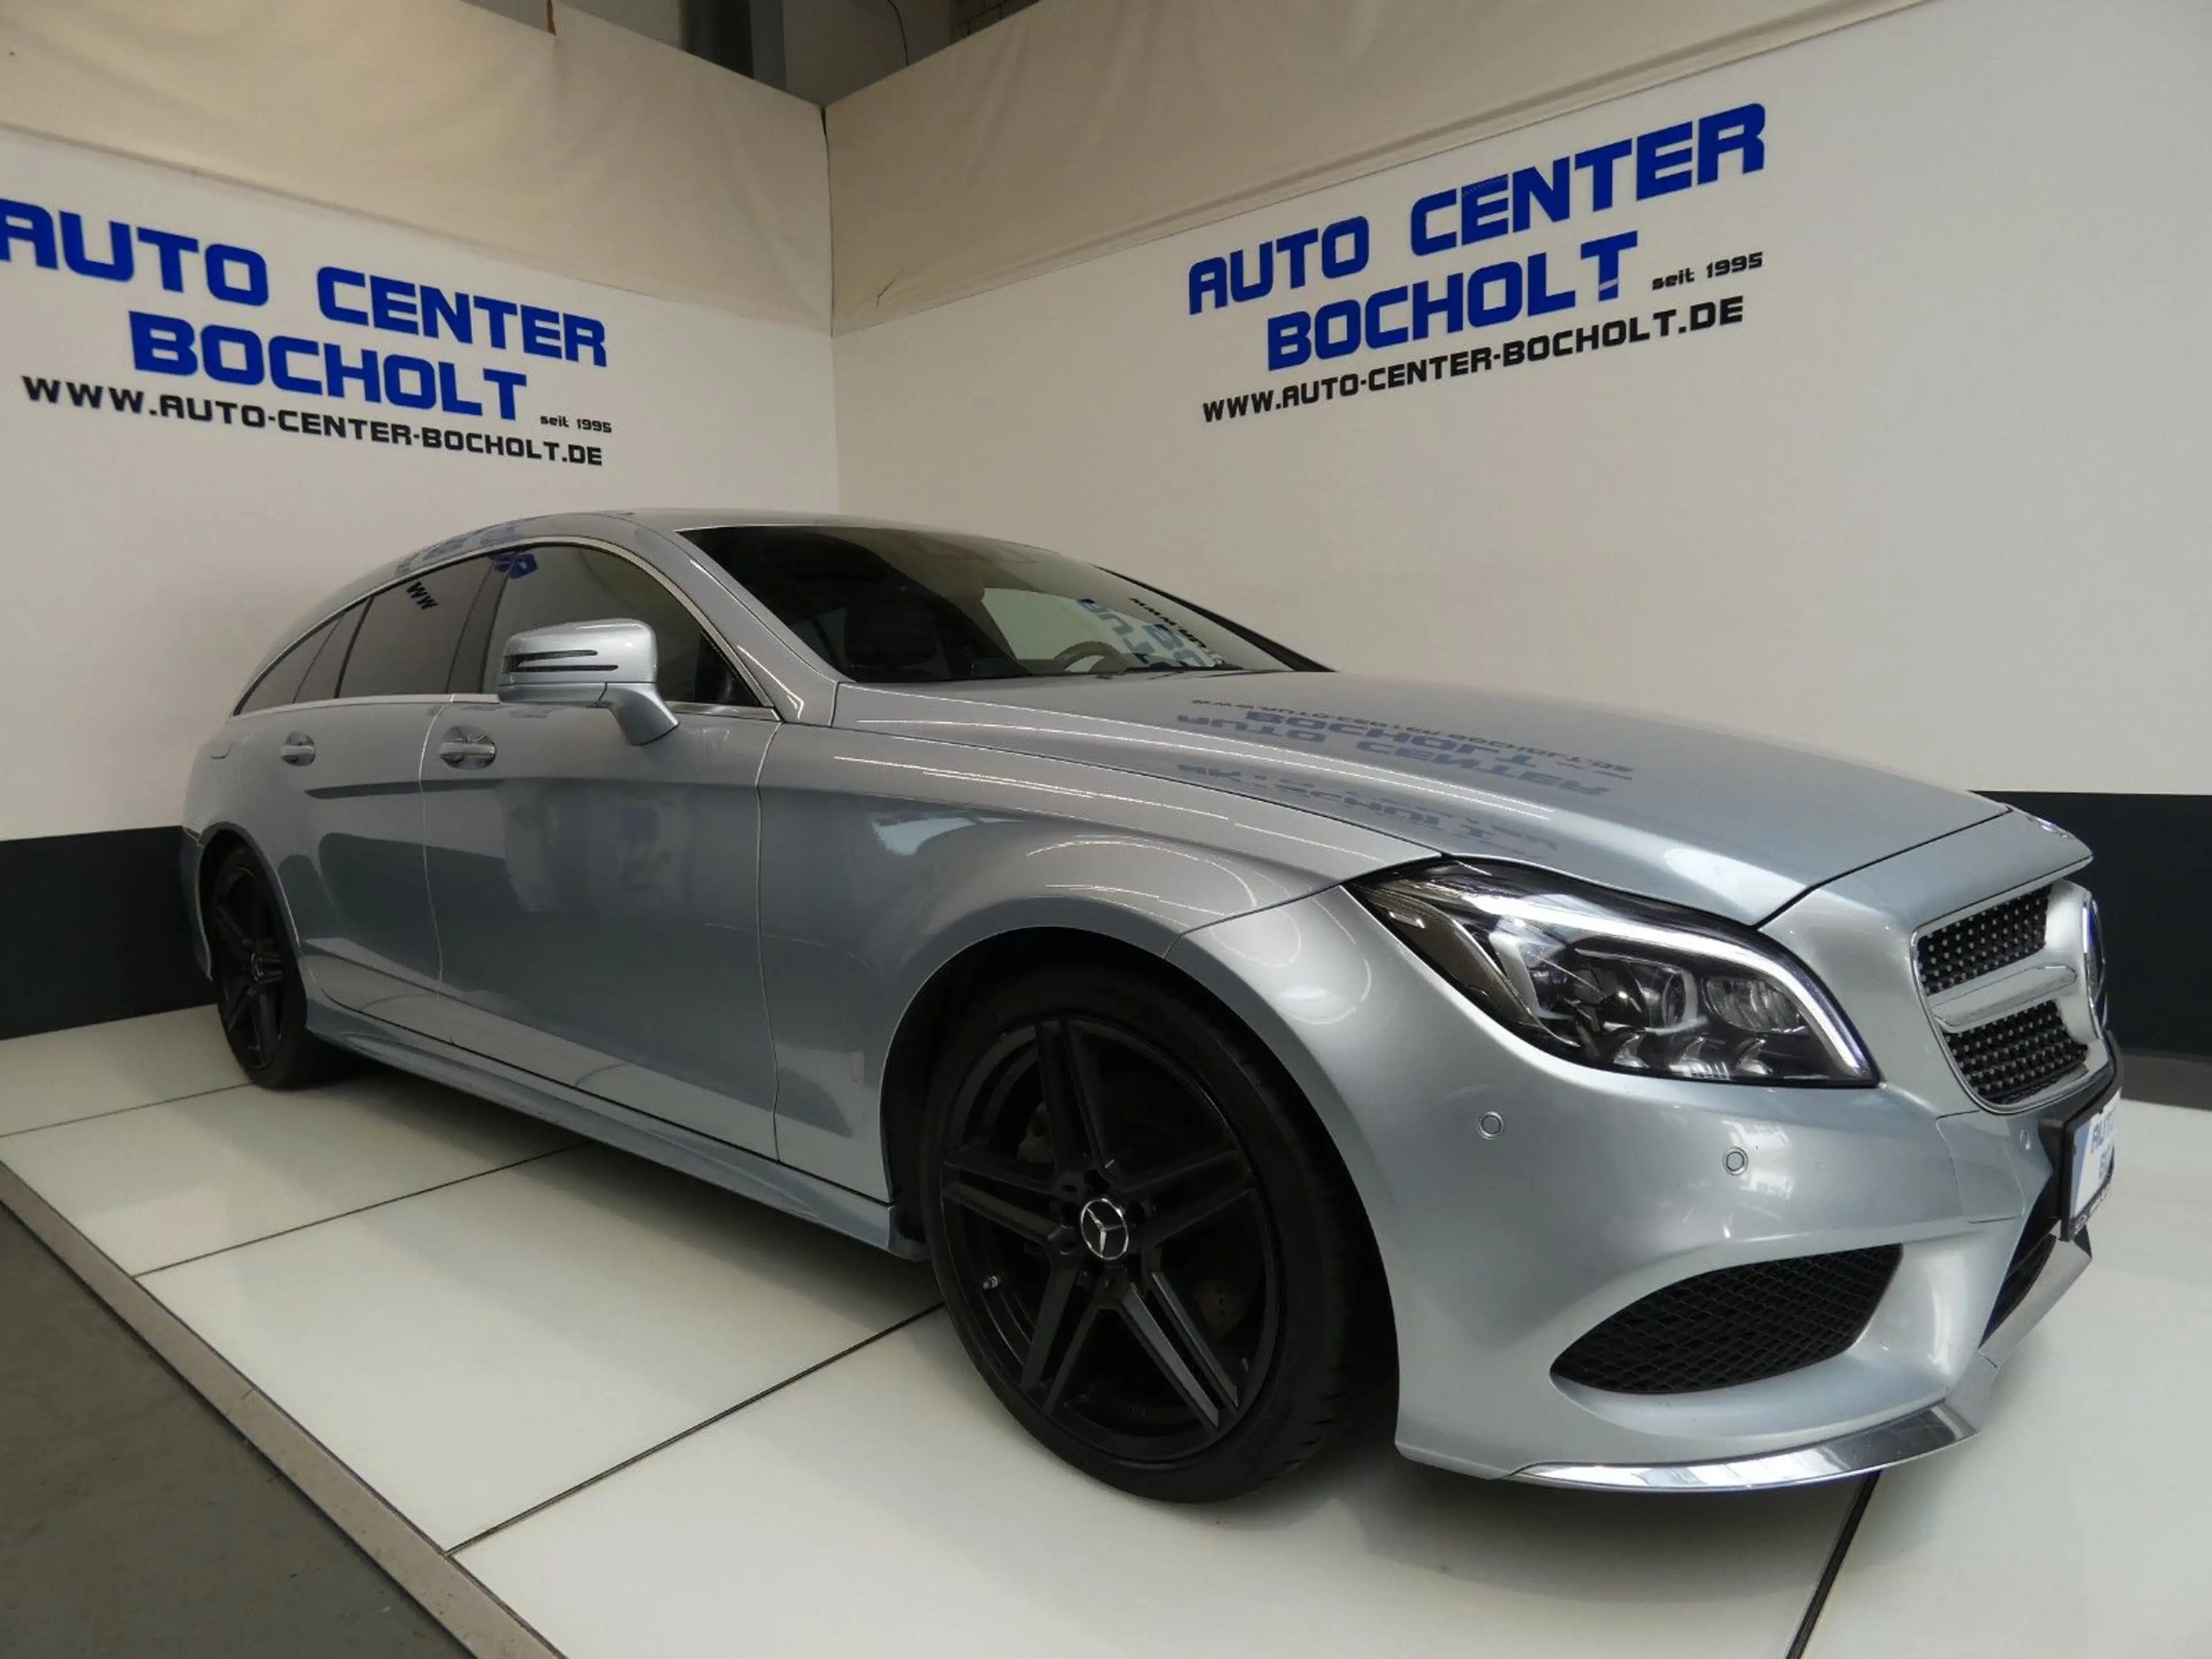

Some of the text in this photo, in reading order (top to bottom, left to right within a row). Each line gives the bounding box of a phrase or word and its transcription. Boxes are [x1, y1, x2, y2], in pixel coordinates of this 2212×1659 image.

[1189, 103, 1766, 315] AUTO CENTER
[0, 199, 607, 367] AUTO CENTER
[1267, 230, 1638, 370] BOCHOLT
[1651, 251, 1763, 291] seit 1995
[128, 310, 528, 422] BOCHOLT
[1202, 295, 1744, 423] WWW.AUTO-CENTER-BOCHOLT.DE
[21, 375, 603, 467] WWW.AUTO-CENTER-BOCHOLT.DE
[539, 414, 612, 433] seit 1995
